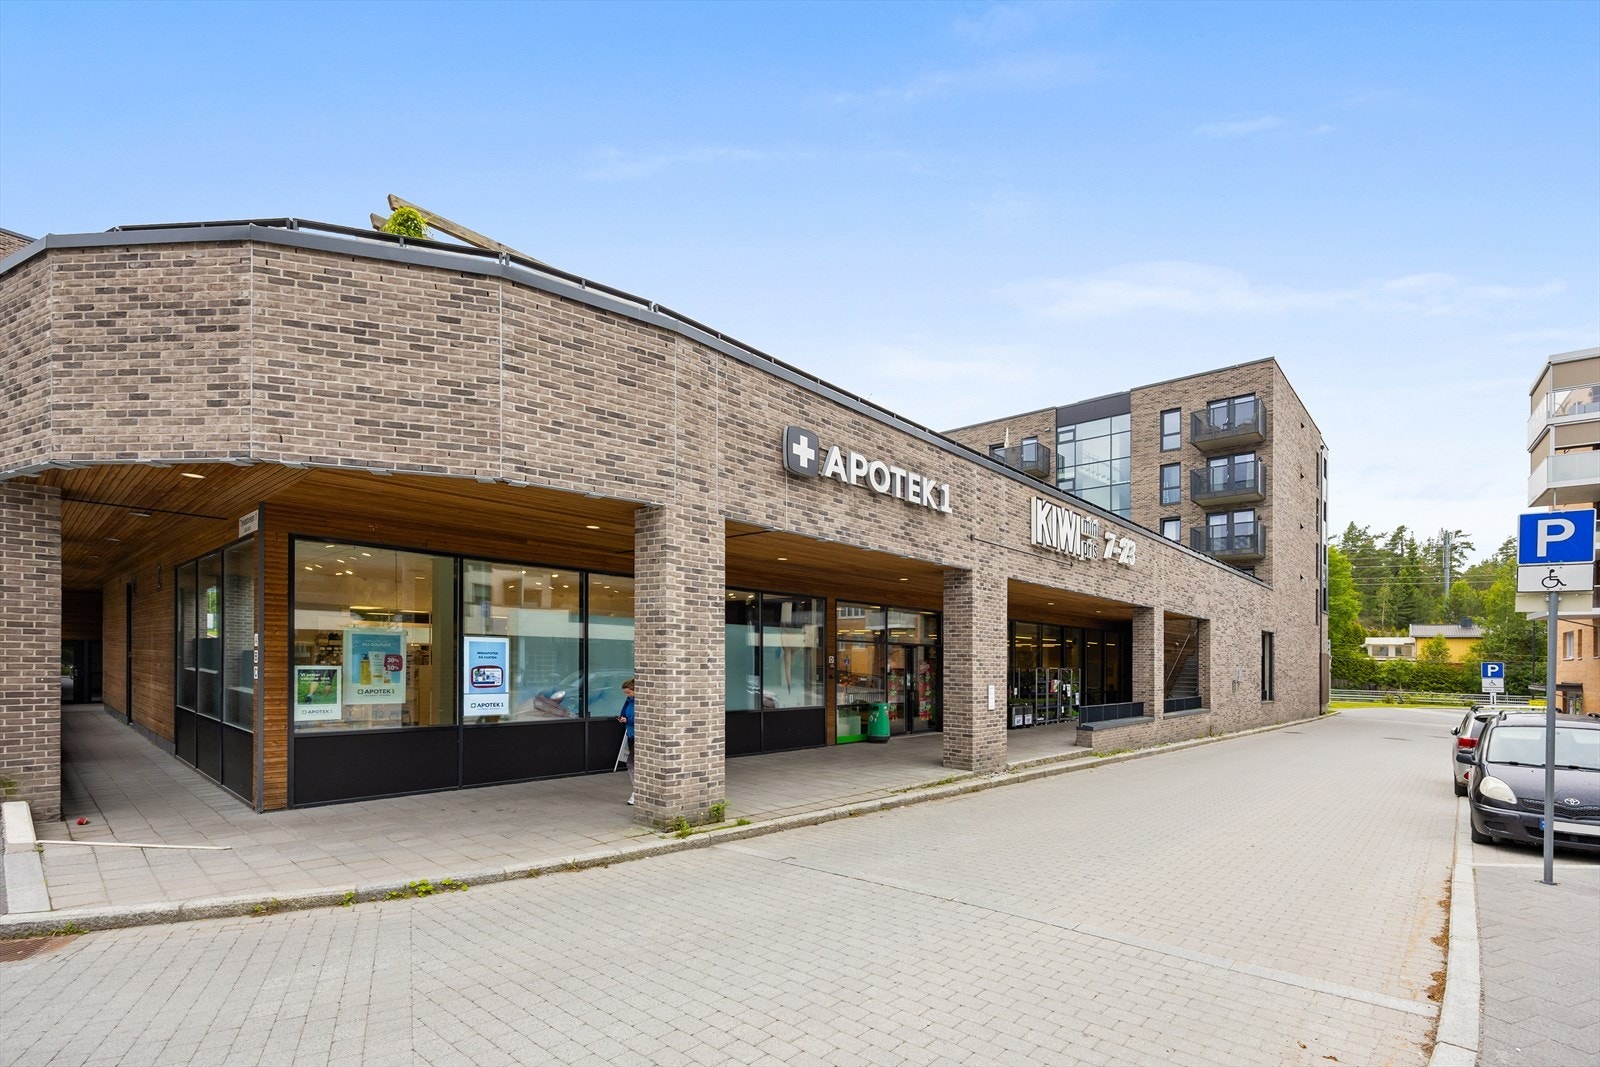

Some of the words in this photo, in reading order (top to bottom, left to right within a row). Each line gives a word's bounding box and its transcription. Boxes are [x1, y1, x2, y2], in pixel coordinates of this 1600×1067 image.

[822, 445, 938, 510] APOTEK
[939, 484, 952, 514] 1
[1032, 497, 1081, 557] KIWI
[1082, 516, 1100, 538] mini
[1537, 518, 1576, 558] P
[1081, 539, 1099, 561] pris
[1487, 664, 1500, 677] P
